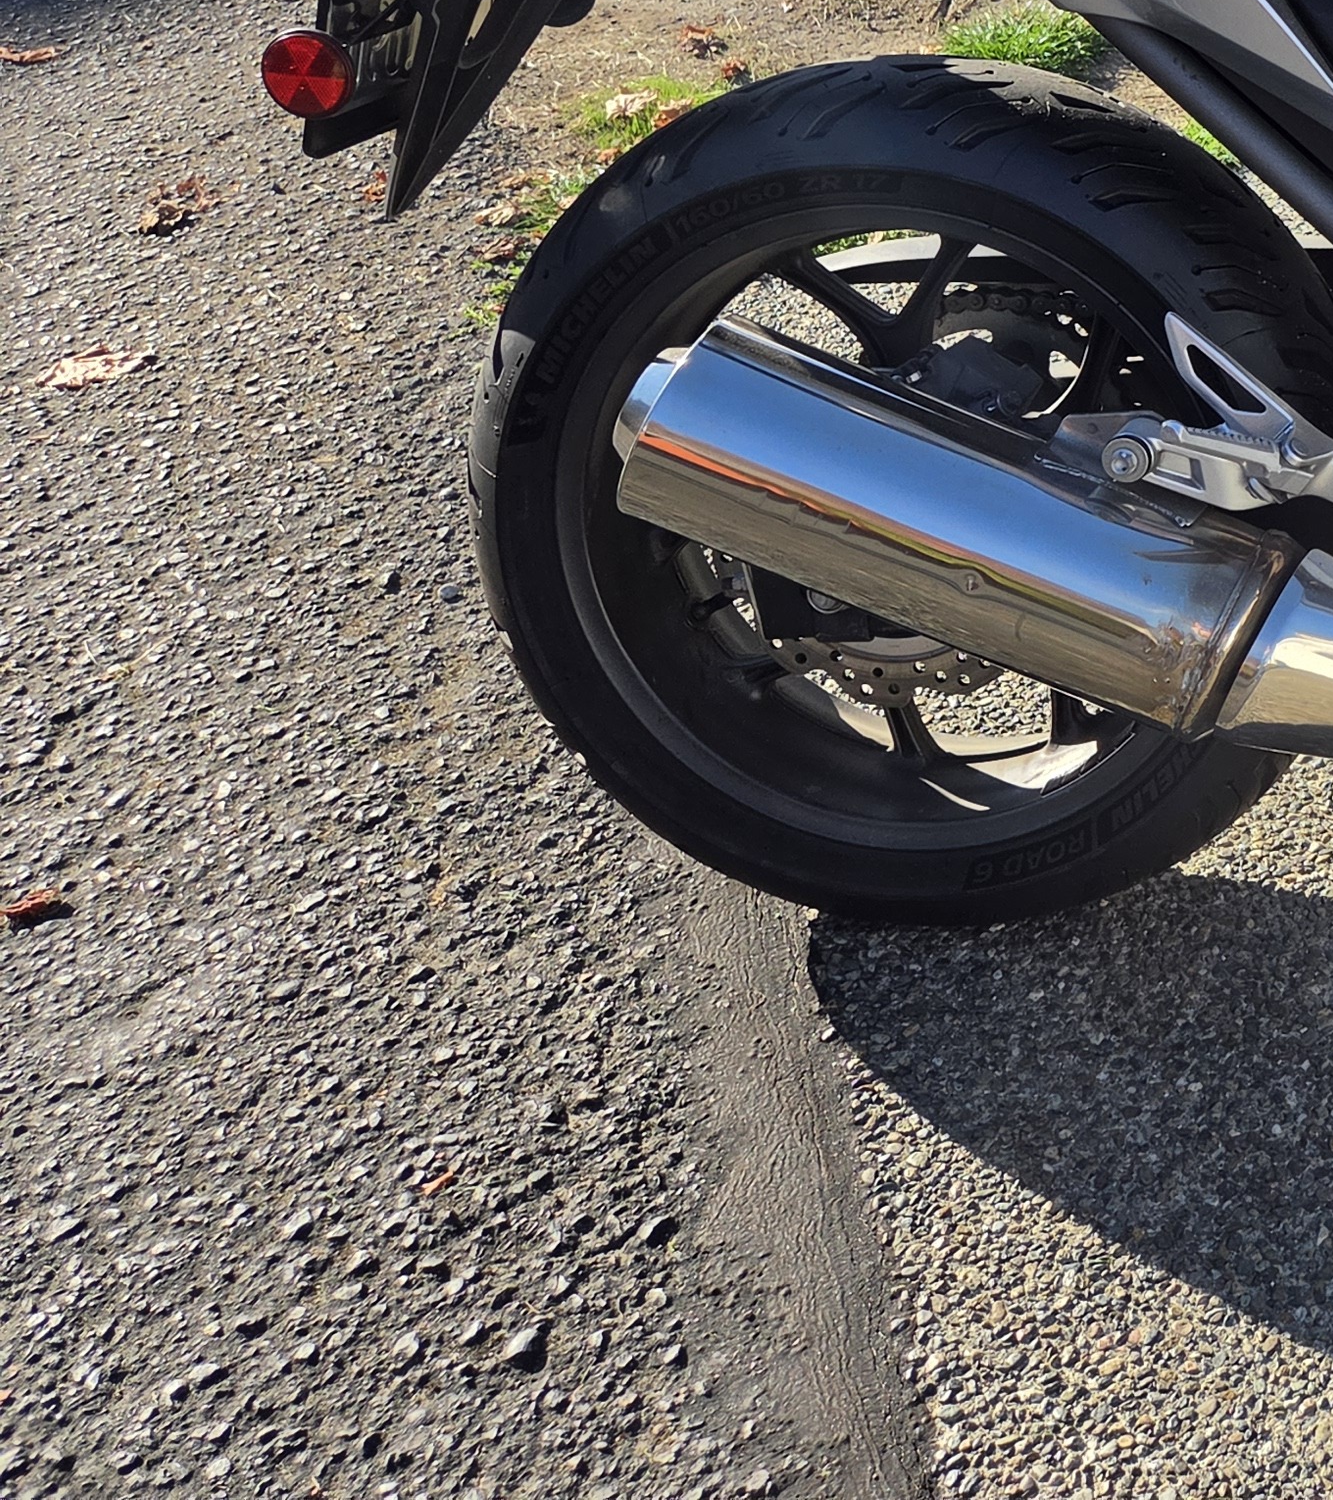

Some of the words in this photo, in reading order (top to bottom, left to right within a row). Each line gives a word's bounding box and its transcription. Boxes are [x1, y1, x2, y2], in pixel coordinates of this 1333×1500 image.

[536, 237, 657, 385] MICHELIN
[675, 181, 786, 234] 160/60
[799, 174, 842, 193] ZR
[1110, 740, 1202, 831] HELIN
[972, 861, 994, 884] 6
[1004, 830, 1085, 877] ROAD
